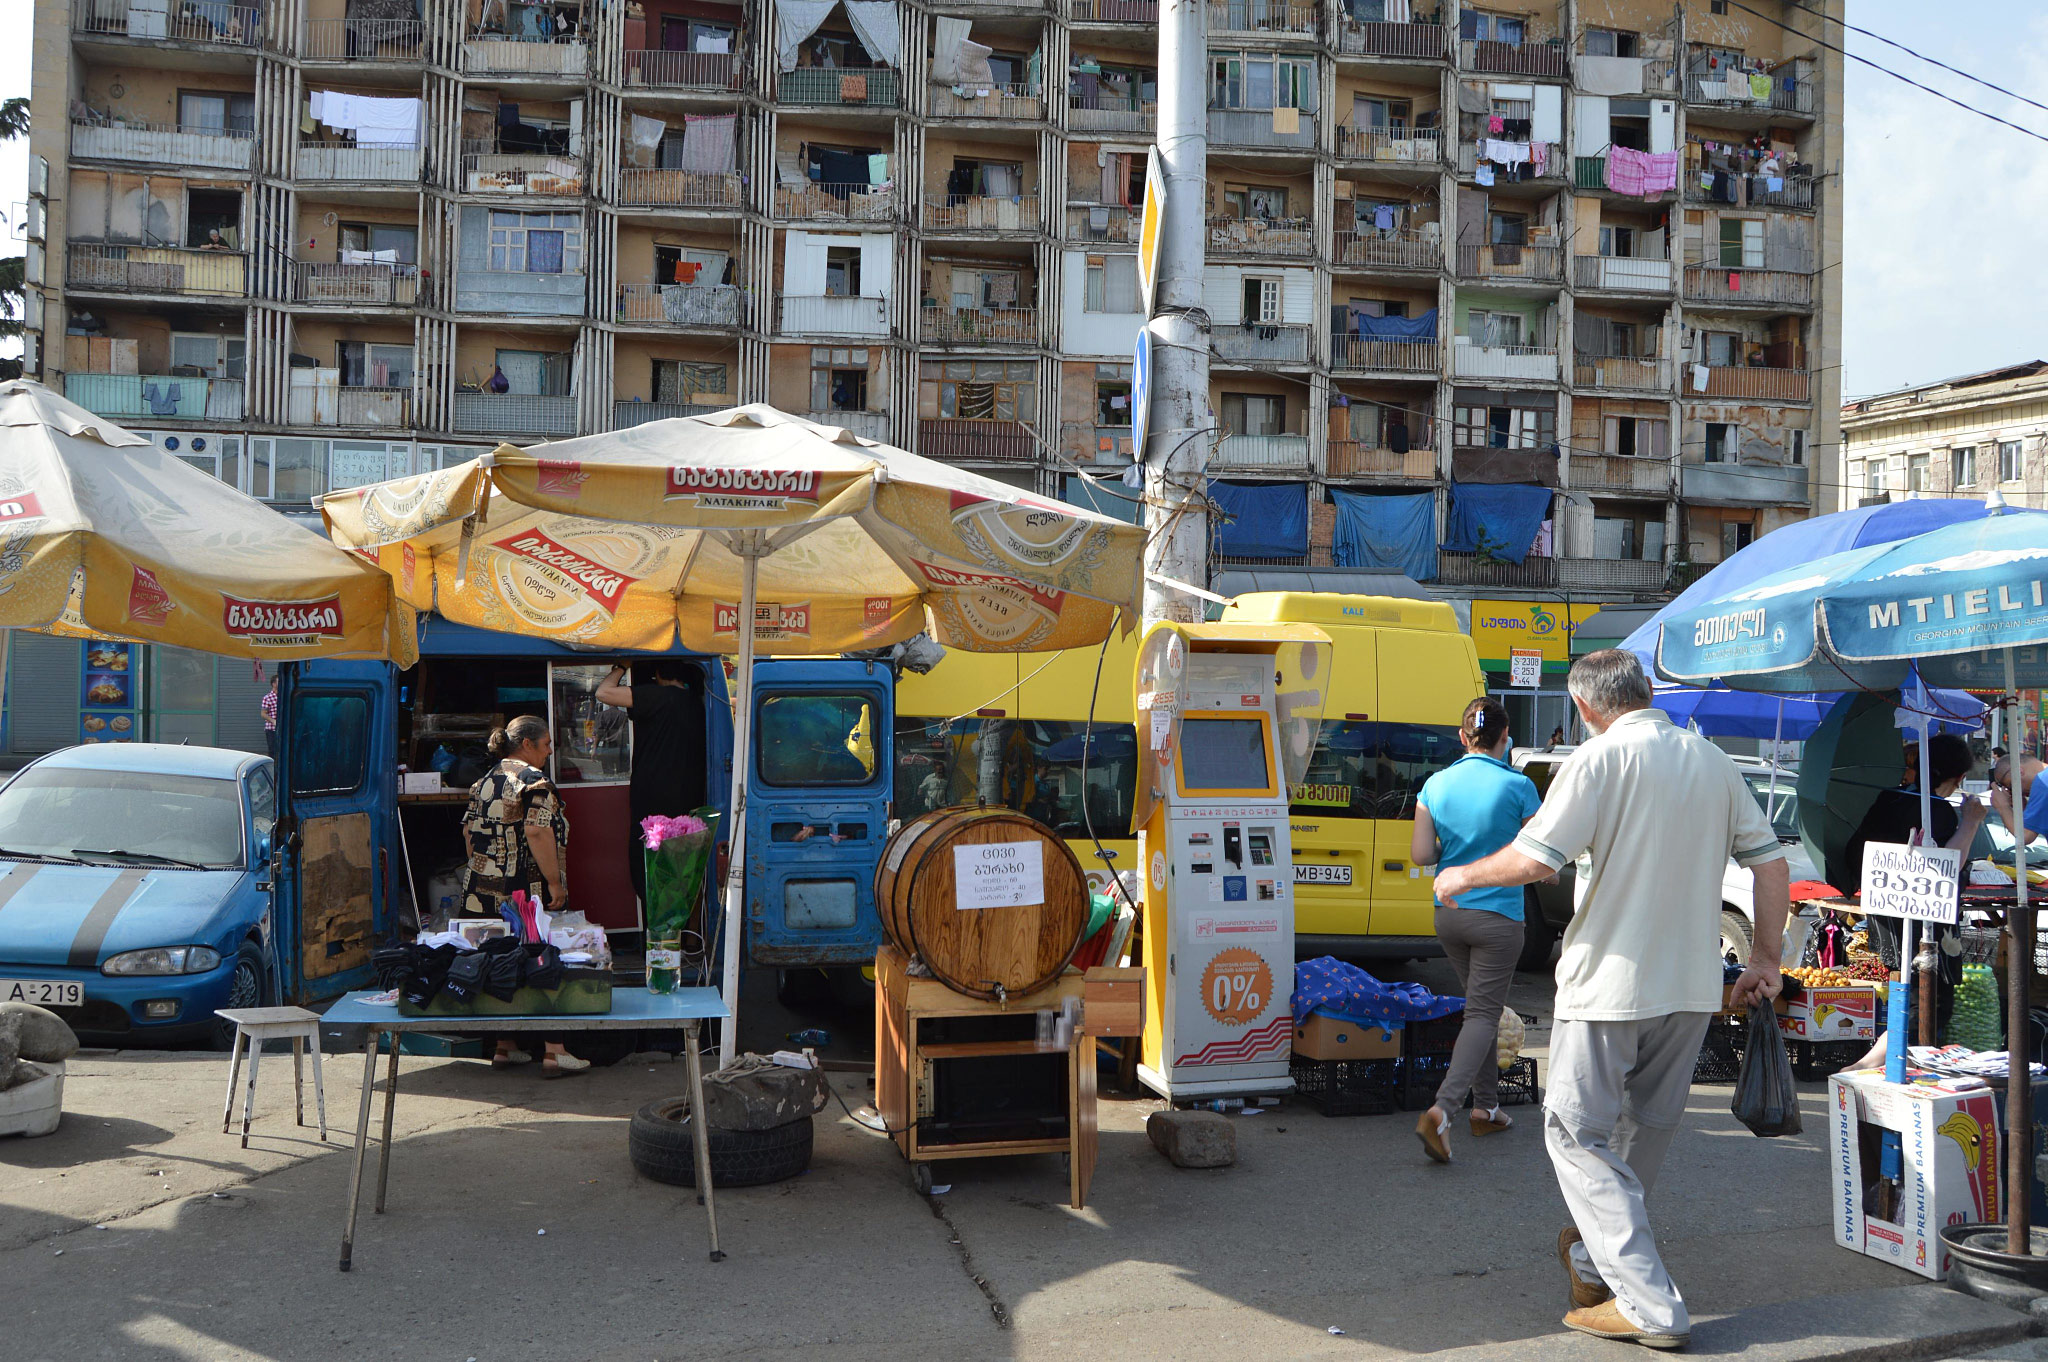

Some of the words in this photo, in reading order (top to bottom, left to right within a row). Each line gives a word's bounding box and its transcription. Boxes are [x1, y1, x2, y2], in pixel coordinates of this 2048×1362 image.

[704, 497, 778, 508] NATAKHTARI
[1342, 607, 1365, 616] KALE
[1869, 580, 2044, 630] MTIELI
[1481, 617, 1527, 630] სუფთა
[1694, 607, 1767, 647] მთიელი
[1914, 628, 1965, 642] GEORGIAN
[1966, 620, 2022, 634] MOUNTAIN
[256, 636, 314, 645] NATAKHTARI
[1521, 667, 1535, 676] 253
[1138, 691, 1174, 709] EXPRESS
[982, 847, 1016, 860] ცივი
[1872, 849, 1957, 879] ტანსაცმლის
[974, 862, 1025, 876] ბურახი
[1292, 866, 1350, 881] MB-945
[1871, 869, 1955, 900] შავი
[1869, 890, 1953, 920] საღებავი
[1213, 974, 1260, 1012] 0%
[1814, 992, 1845, 1000] BANANAS
[1846, 992, 1873, 1000] PREMIUM
[1837, 1085, 1847, 1112] Dole
[1840, 1113, 1851, 1177] PREMIUM
[1912, 1102, 1924, 1166] BANANAS
[1984, 1122, 1995, 1181] BANANAS
[1843, 1180, 1854, 1242] BANANAS
[1915, 1171, 1925, 1237] PREMIUM
[1986, 1184, 1996, 1223] MIUM
[1916, 1239, 1926, 1268] Dole
